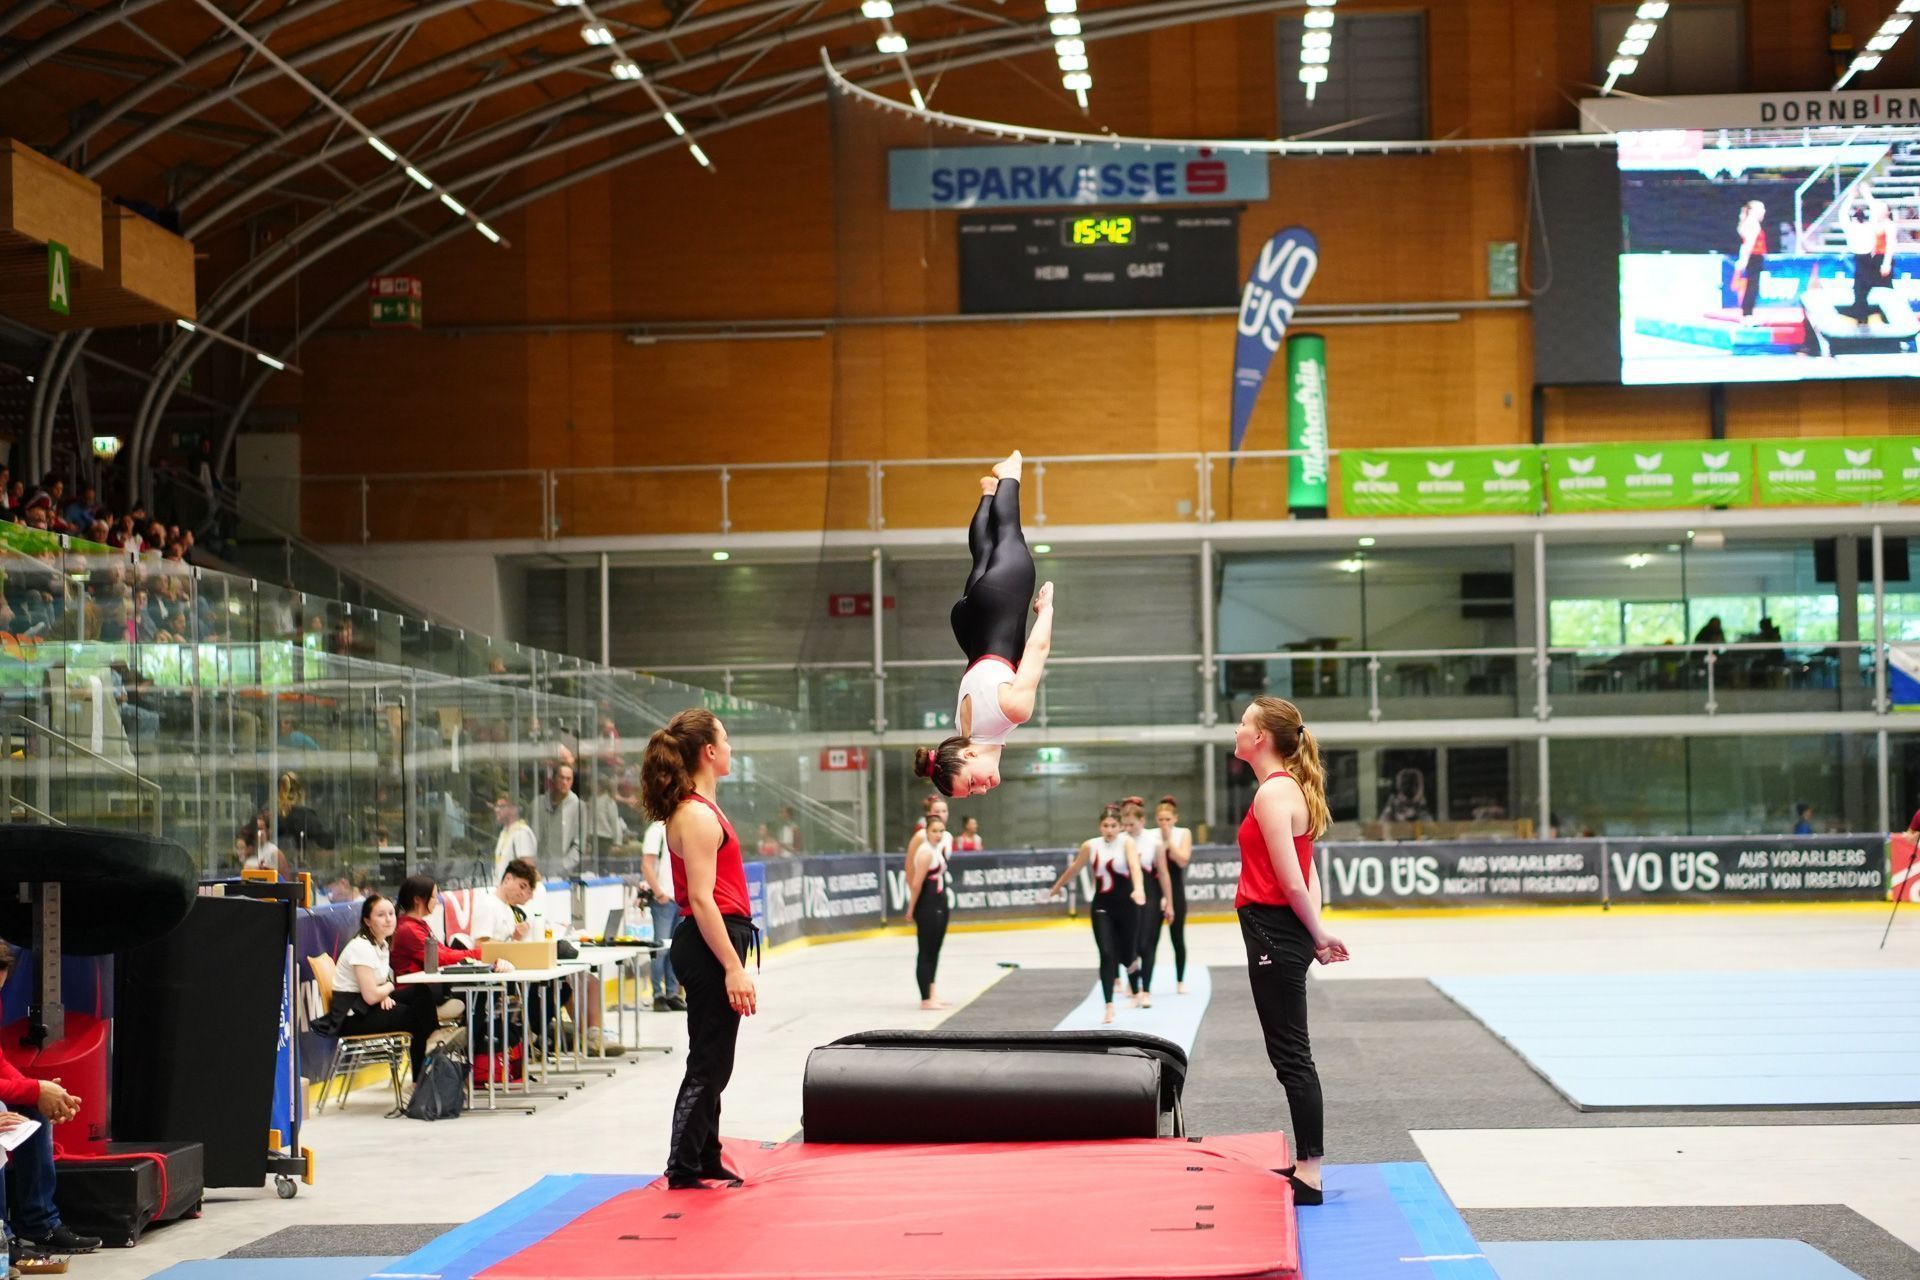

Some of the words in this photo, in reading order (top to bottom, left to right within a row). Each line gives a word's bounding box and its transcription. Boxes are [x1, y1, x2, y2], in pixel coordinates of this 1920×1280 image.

[1760, 94, 1920, 122] DORNBIRN
[931, 162, 1177, 202] SPARKASSE
[1072, 217, 1132, 245] 15:42
[51, 250, 68, 306] A
[1034, 265, 1069, 281] HEIM
[1127, 262, 1165, 278] GAST
[1258, 238, 1318, 299] VO
[1238, 281, 1294, 352] ÜS
[1187, 862, 1214, 878] AUS
[1457, 856, 1487, 872] AUS
[1612, 852, 1663, 891] VO
[1670, 851, 1720, 891] ÜS
[1738, 851, 1768, 868] AUS
[1770, 849, 1866, 867] VORARLBERG
[1333, 857, 1384, 896] VO
[1390, 856, 1439, 896] ÜS
[1443, 876, 1488, 894] NICHT
[1489, 876, 1521, 893] VON
[1522, 874, 1599, 893] IRGENDWO
[1724, 872, 1769, 890] NICHT
[1770, 872, 1803, 890] VON
[1804, 870, 1882, 889] IRGENDWO
